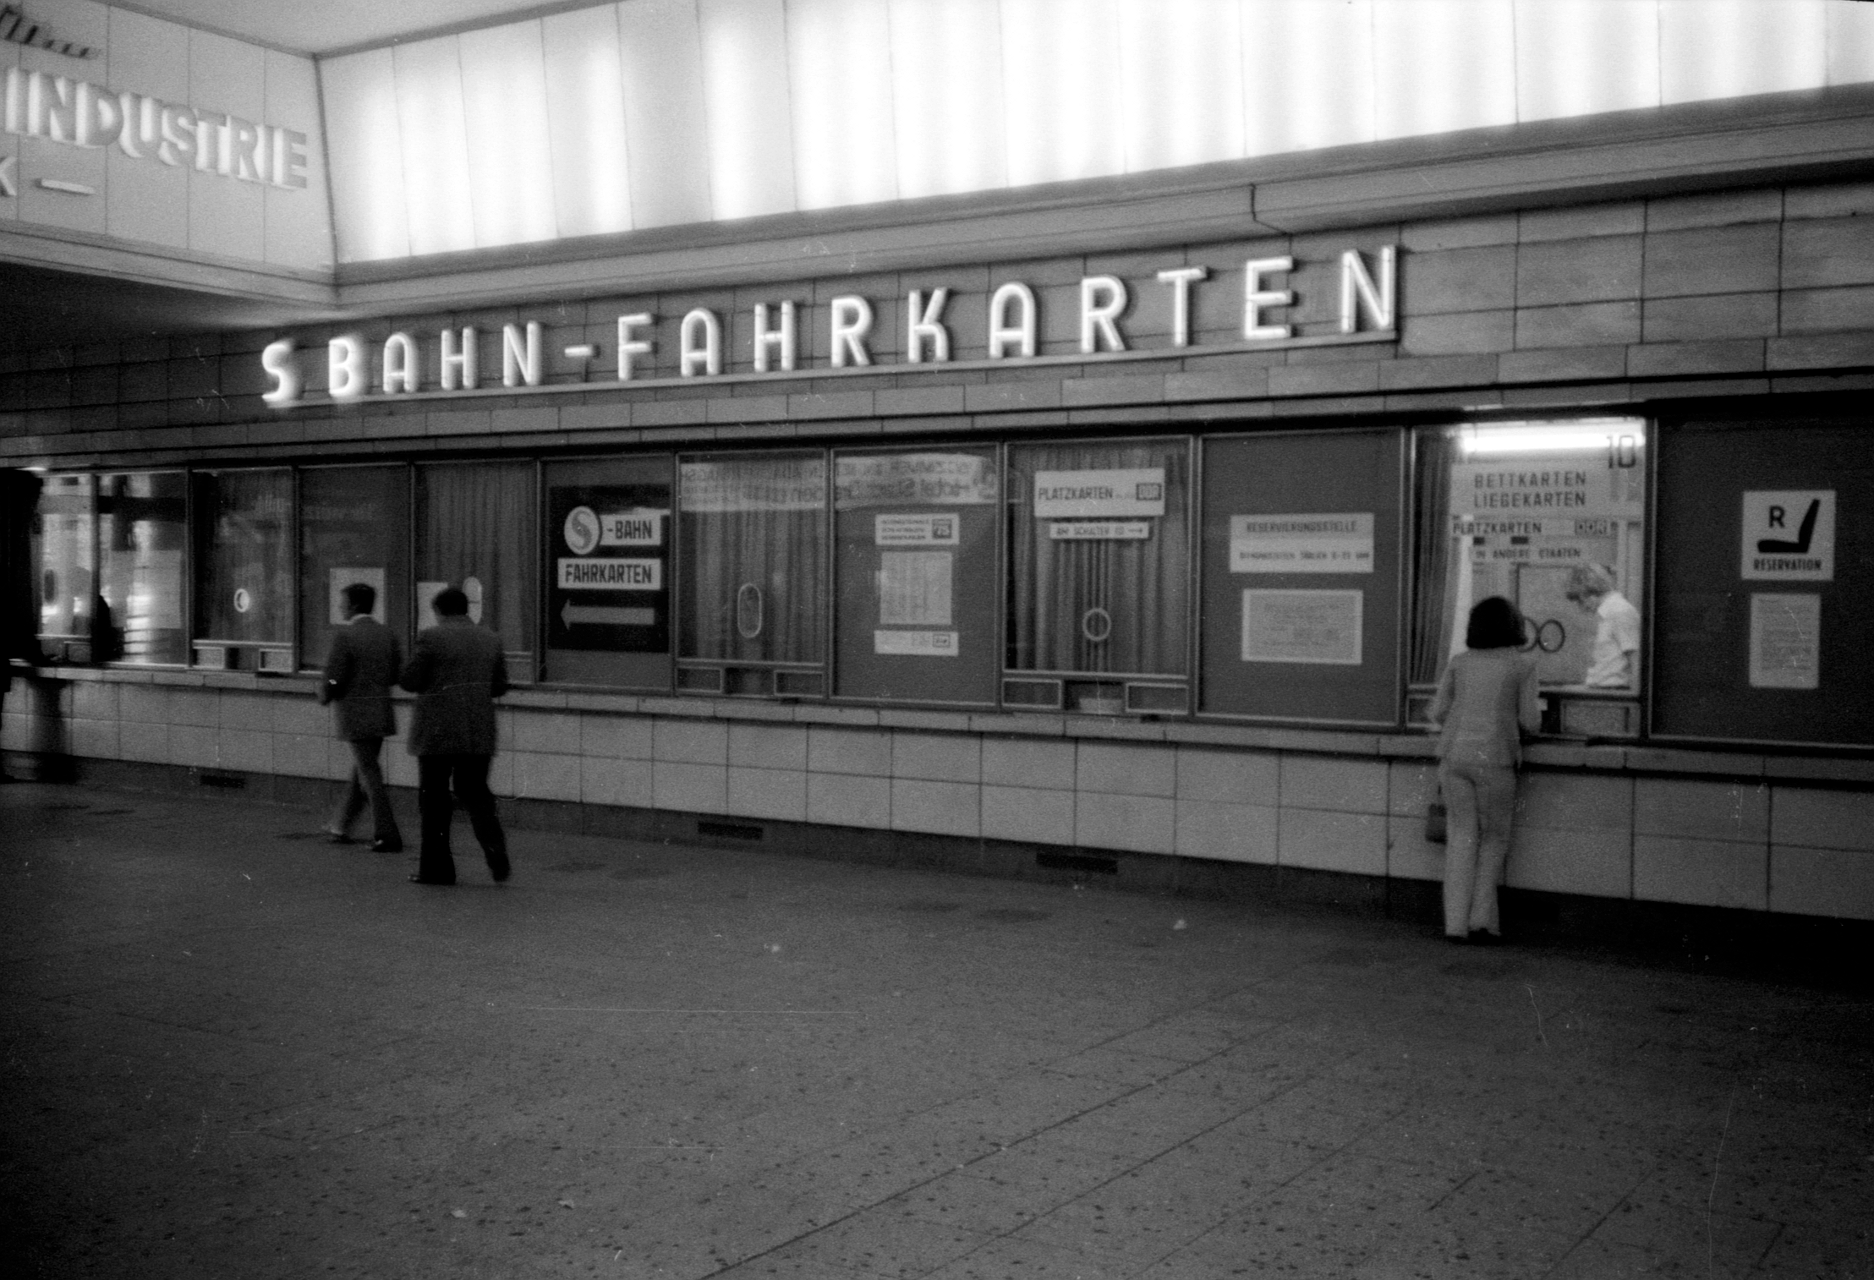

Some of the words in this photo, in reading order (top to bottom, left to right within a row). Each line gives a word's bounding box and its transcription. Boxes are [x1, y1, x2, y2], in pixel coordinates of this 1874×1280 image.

[5, 65, 307, 189] INDUSTRIE
[1606, 435, 1637, 469] 10
[1474, 471, 1587, 489] BETTKARTEN
[1038, 486, 1114, 501] PLATZKARTEN
[1474, 491, 1586, 508] LIEGEKARTEN
[1769, 505, 1785, 528] R
[1453, 522, 1542, 535] PLATZKARTEN
[565, 564, 653, 584] FAHRKARTEN
[1753, 559, 1822, 571] RESERVATION
